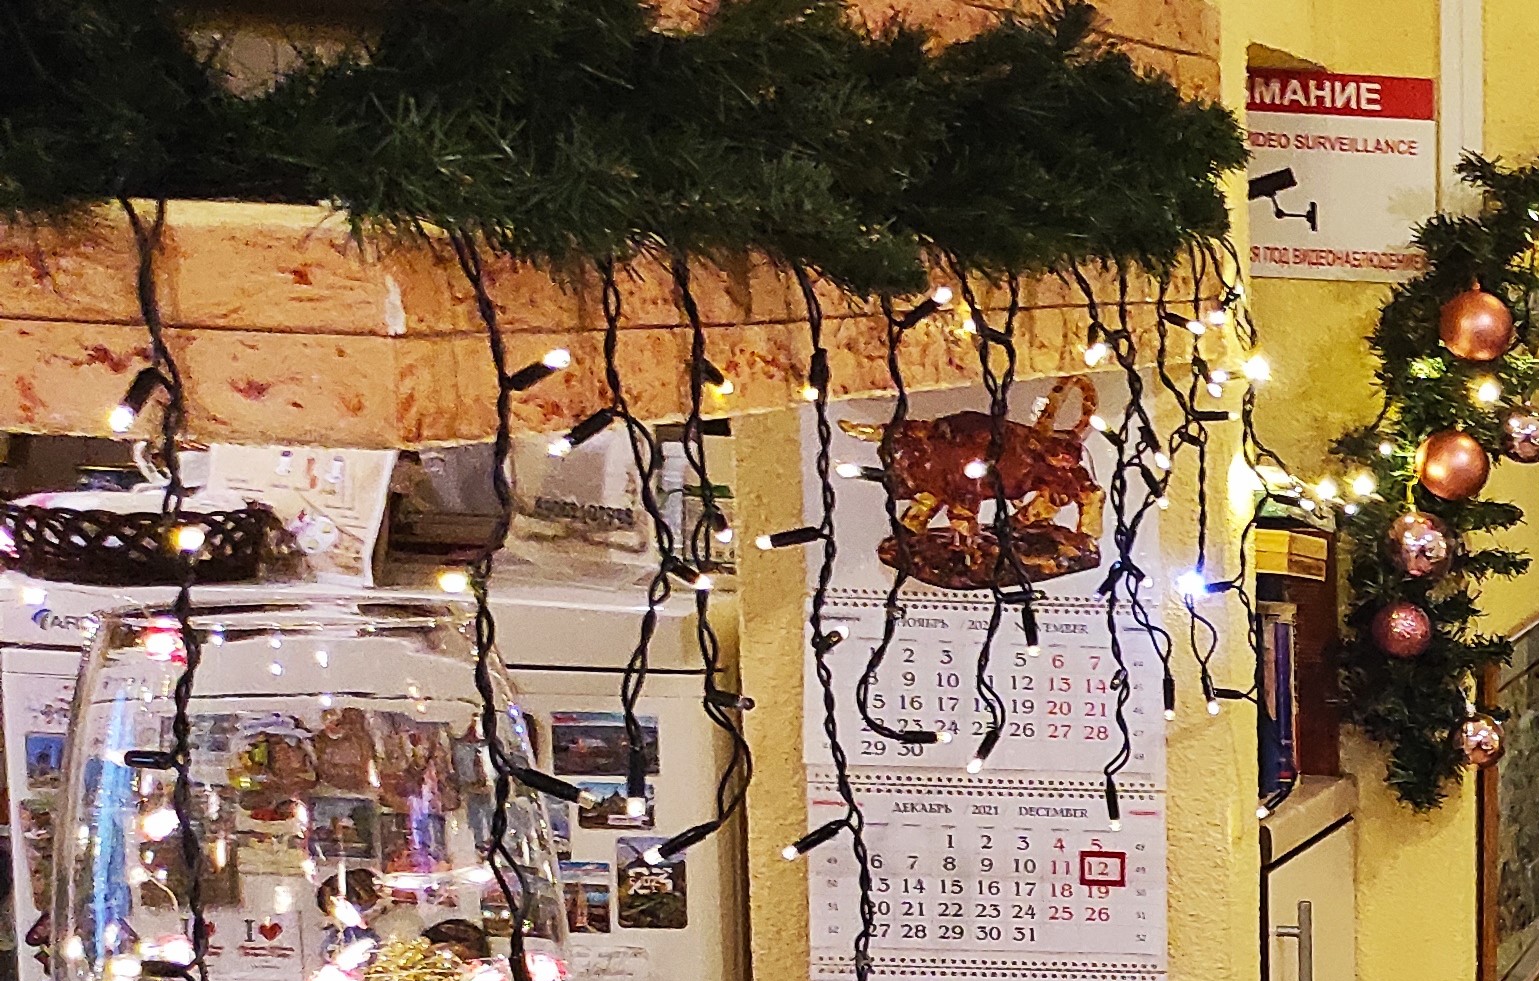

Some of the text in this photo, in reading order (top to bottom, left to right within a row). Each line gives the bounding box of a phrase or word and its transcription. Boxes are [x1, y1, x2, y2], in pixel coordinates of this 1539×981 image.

[1246, 77, 1382, 111] МАНИЕ
[1293, 133, 1419, 155] SURVEILLANCE
[968, 619, 990, 631] 202
[1014, 622, 1089, 634] NEMBER
[903, 648, 915, 663] 2
[940, 650, 953, 664] 3
[1014, 652, 1027, 667] 5
[1052, 654, 1065, 669] 6
[1089, 656, 1101, 670] 7
[903, 671, 916, 686] 9
[936, 672, 960, 688] 10
[1011, 675, 1034, 691] 12
[1049, 677, 1071, 692] 13
[1086, 678, 1108, 694] 14
[900, 694, 923, 710] 16
[937, 697, 960, 712] 17
[1011, 699, 1035, 714] 19
[1046, 701, 1072, 716] 20
[1084, 702, 1107, 717] 21
[934, 719, 960, 735] 24
[1009, 722, 1035, 738] 26
[1047, 724, 1072, 739] 27
[1084, 725, 1109, 741] 28
[860, 740, 886, 756] 29
[897, 741, 924, 756] 30
[893, 801, 1089, 819] ДЕКАБРЬ 2021 DECEMBER
[946, 834, 955, 849] 1
[981, 834, 993, 850] 2
[1016, 836, 1030, 851] 3
[1053, 837, 1066, 852] 4
[1091, 838, 1103, 851] 5
[871, 854, 883, 869] 6
[907, 855, 919, 870] 7
[942, 856, 957, 872] 8
[981, 857, 994, 872] 9
[1013, 858, 1037, 874] 10
[1051, 860, 1071, 876] 11
[1086, 861, 1109, 877] 12
[902, 878, 926, 894] 14
[940, 879, 964, 895] 15
[977, 880, 1000, 896] 16
[1014, 881, 1037, 897] 17
[1051, 883, 1074, 898] 18
[1087, 885, 1110, 899] 19
[901, 901, 925, 916] 21
[938, 902, 963, 918] 22
[974, 903, 1001, 919] 23
[1011, 904, 1036, 919] 24
[1048, 906, 1074, 921] 25
[1085, 907, 1110, 922] 26
[868, 923, 891, 938] 27
[901, 924, 927, 939] 28
[938, 925, 964, 940] 29
[976, 926, 1002, 941] 30
[1012, 926, 1036, 942] 31
